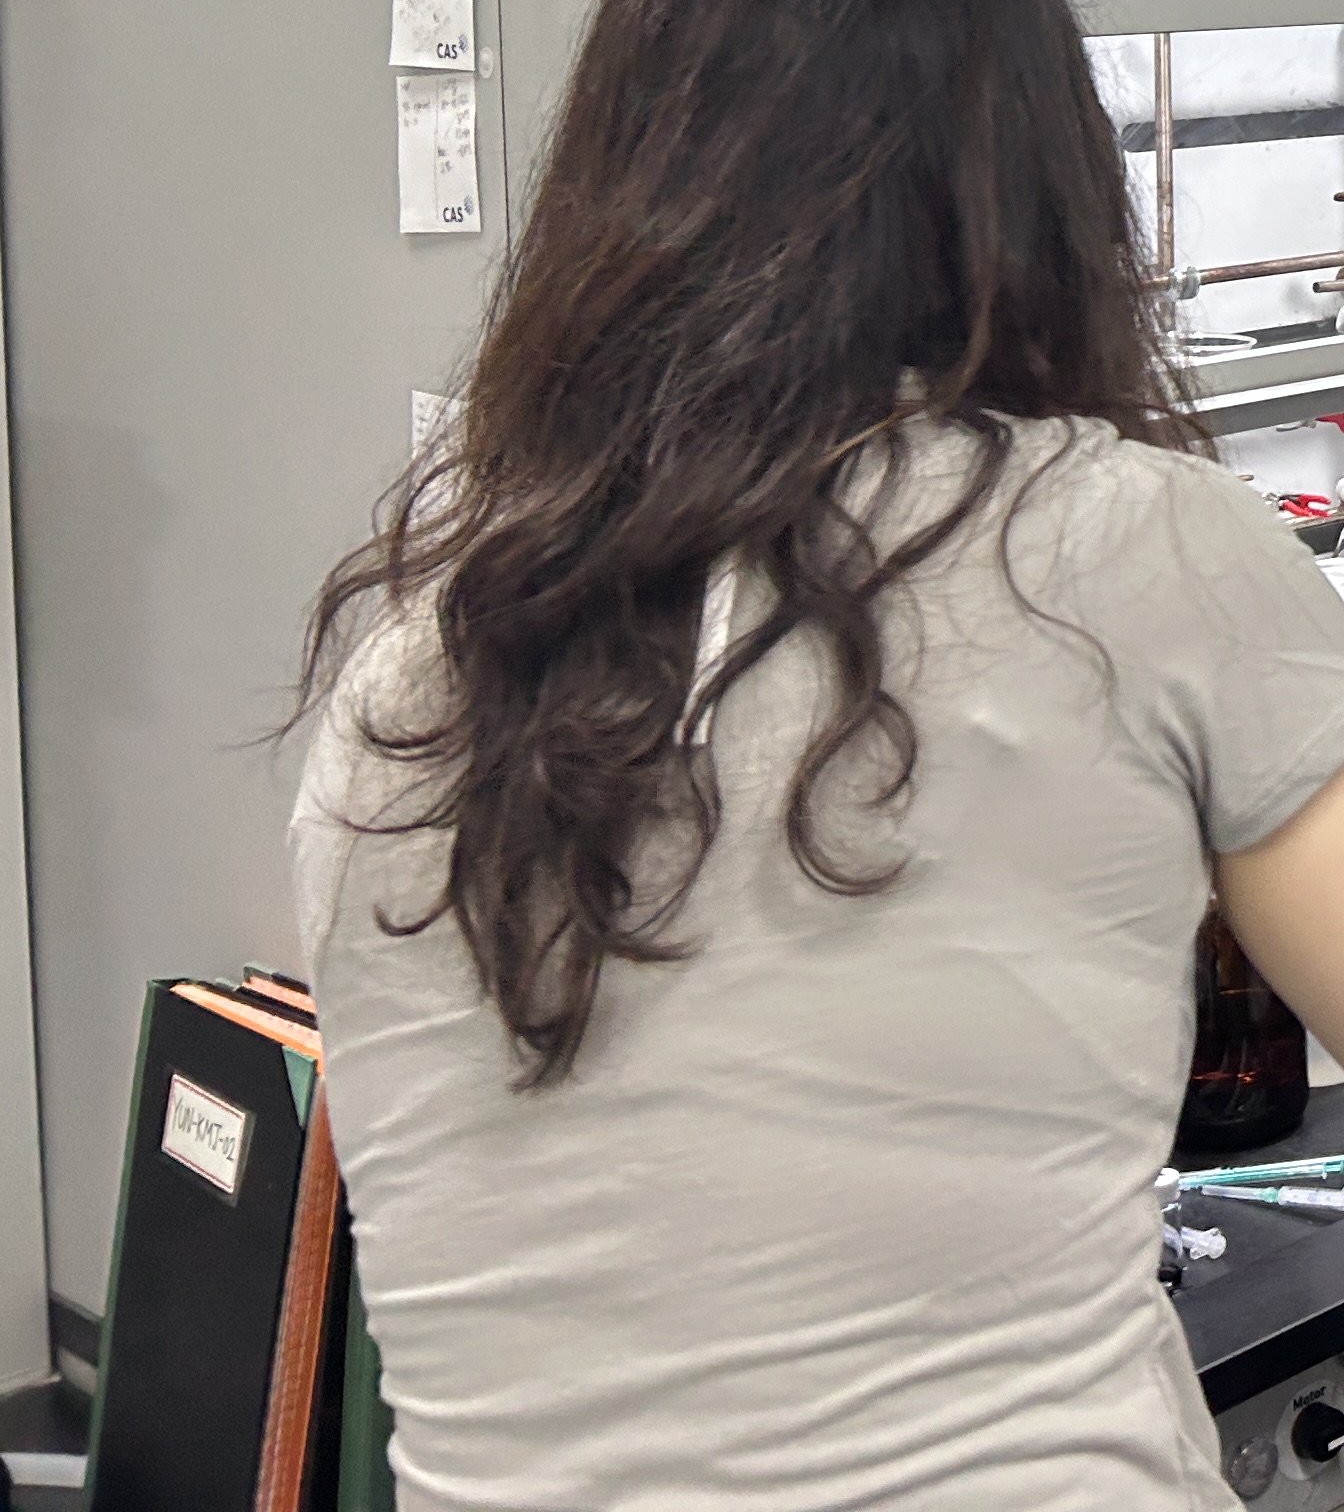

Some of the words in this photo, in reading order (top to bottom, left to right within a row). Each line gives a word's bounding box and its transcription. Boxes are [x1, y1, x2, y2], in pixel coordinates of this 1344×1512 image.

[437, 42, 457, 59] CAS
[443, 206, 463, 223] CAS
[1292, 1385, 1327, 1412] Motor
